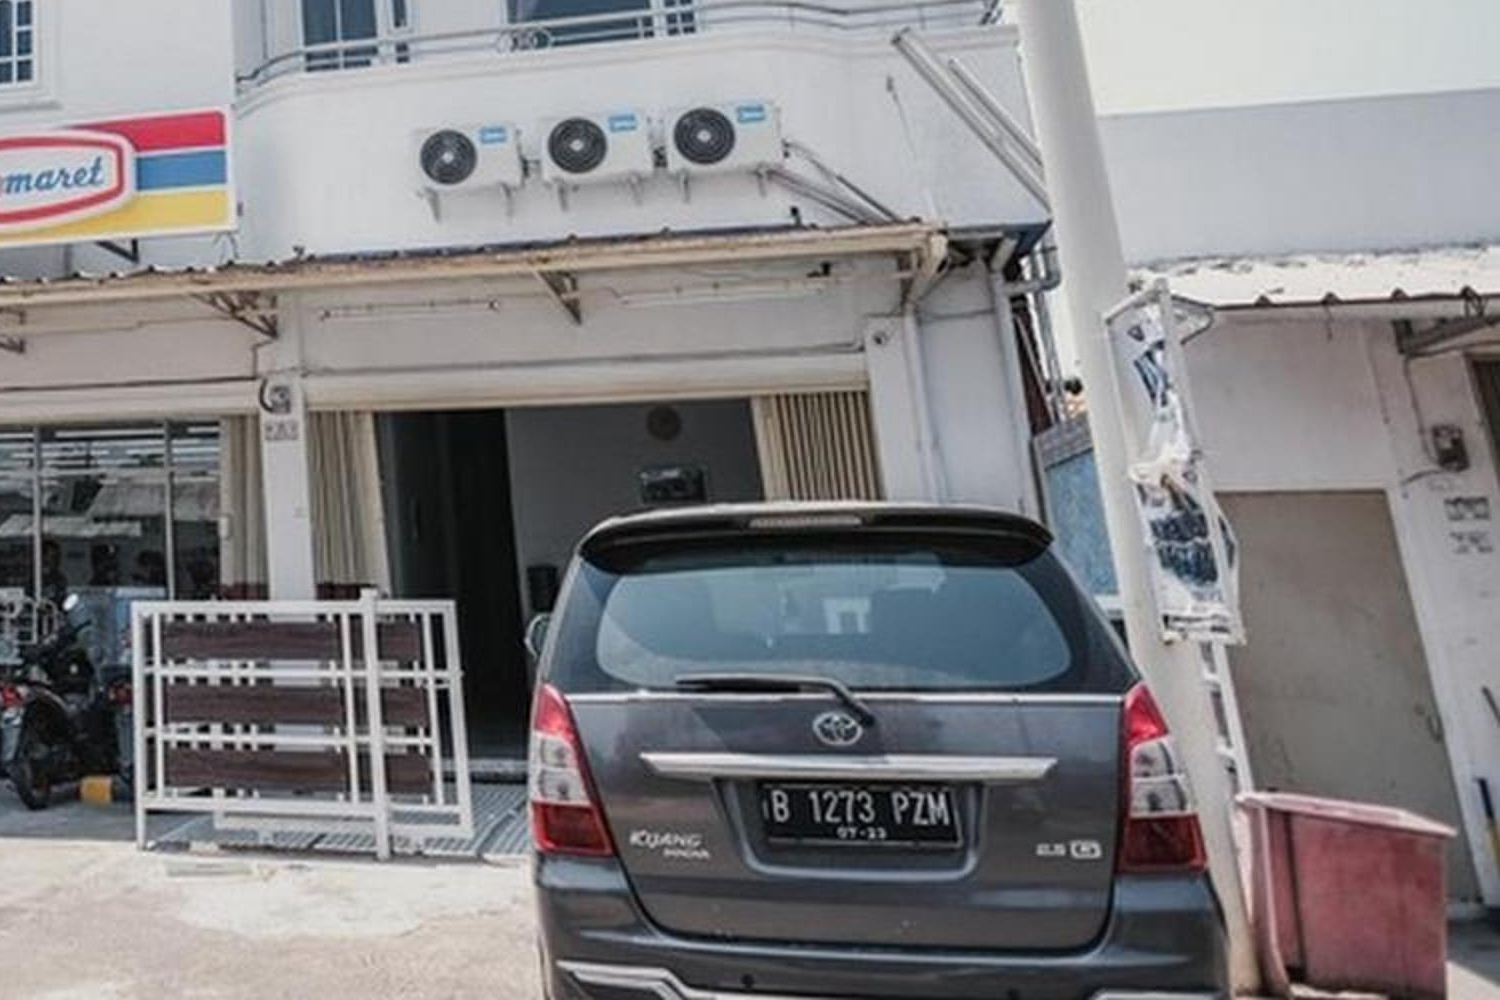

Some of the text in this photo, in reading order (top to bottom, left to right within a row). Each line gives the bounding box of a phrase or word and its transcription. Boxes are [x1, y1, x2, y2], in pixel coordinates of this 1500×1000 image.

[771, 789, 950, 826] B 1273 PZM
